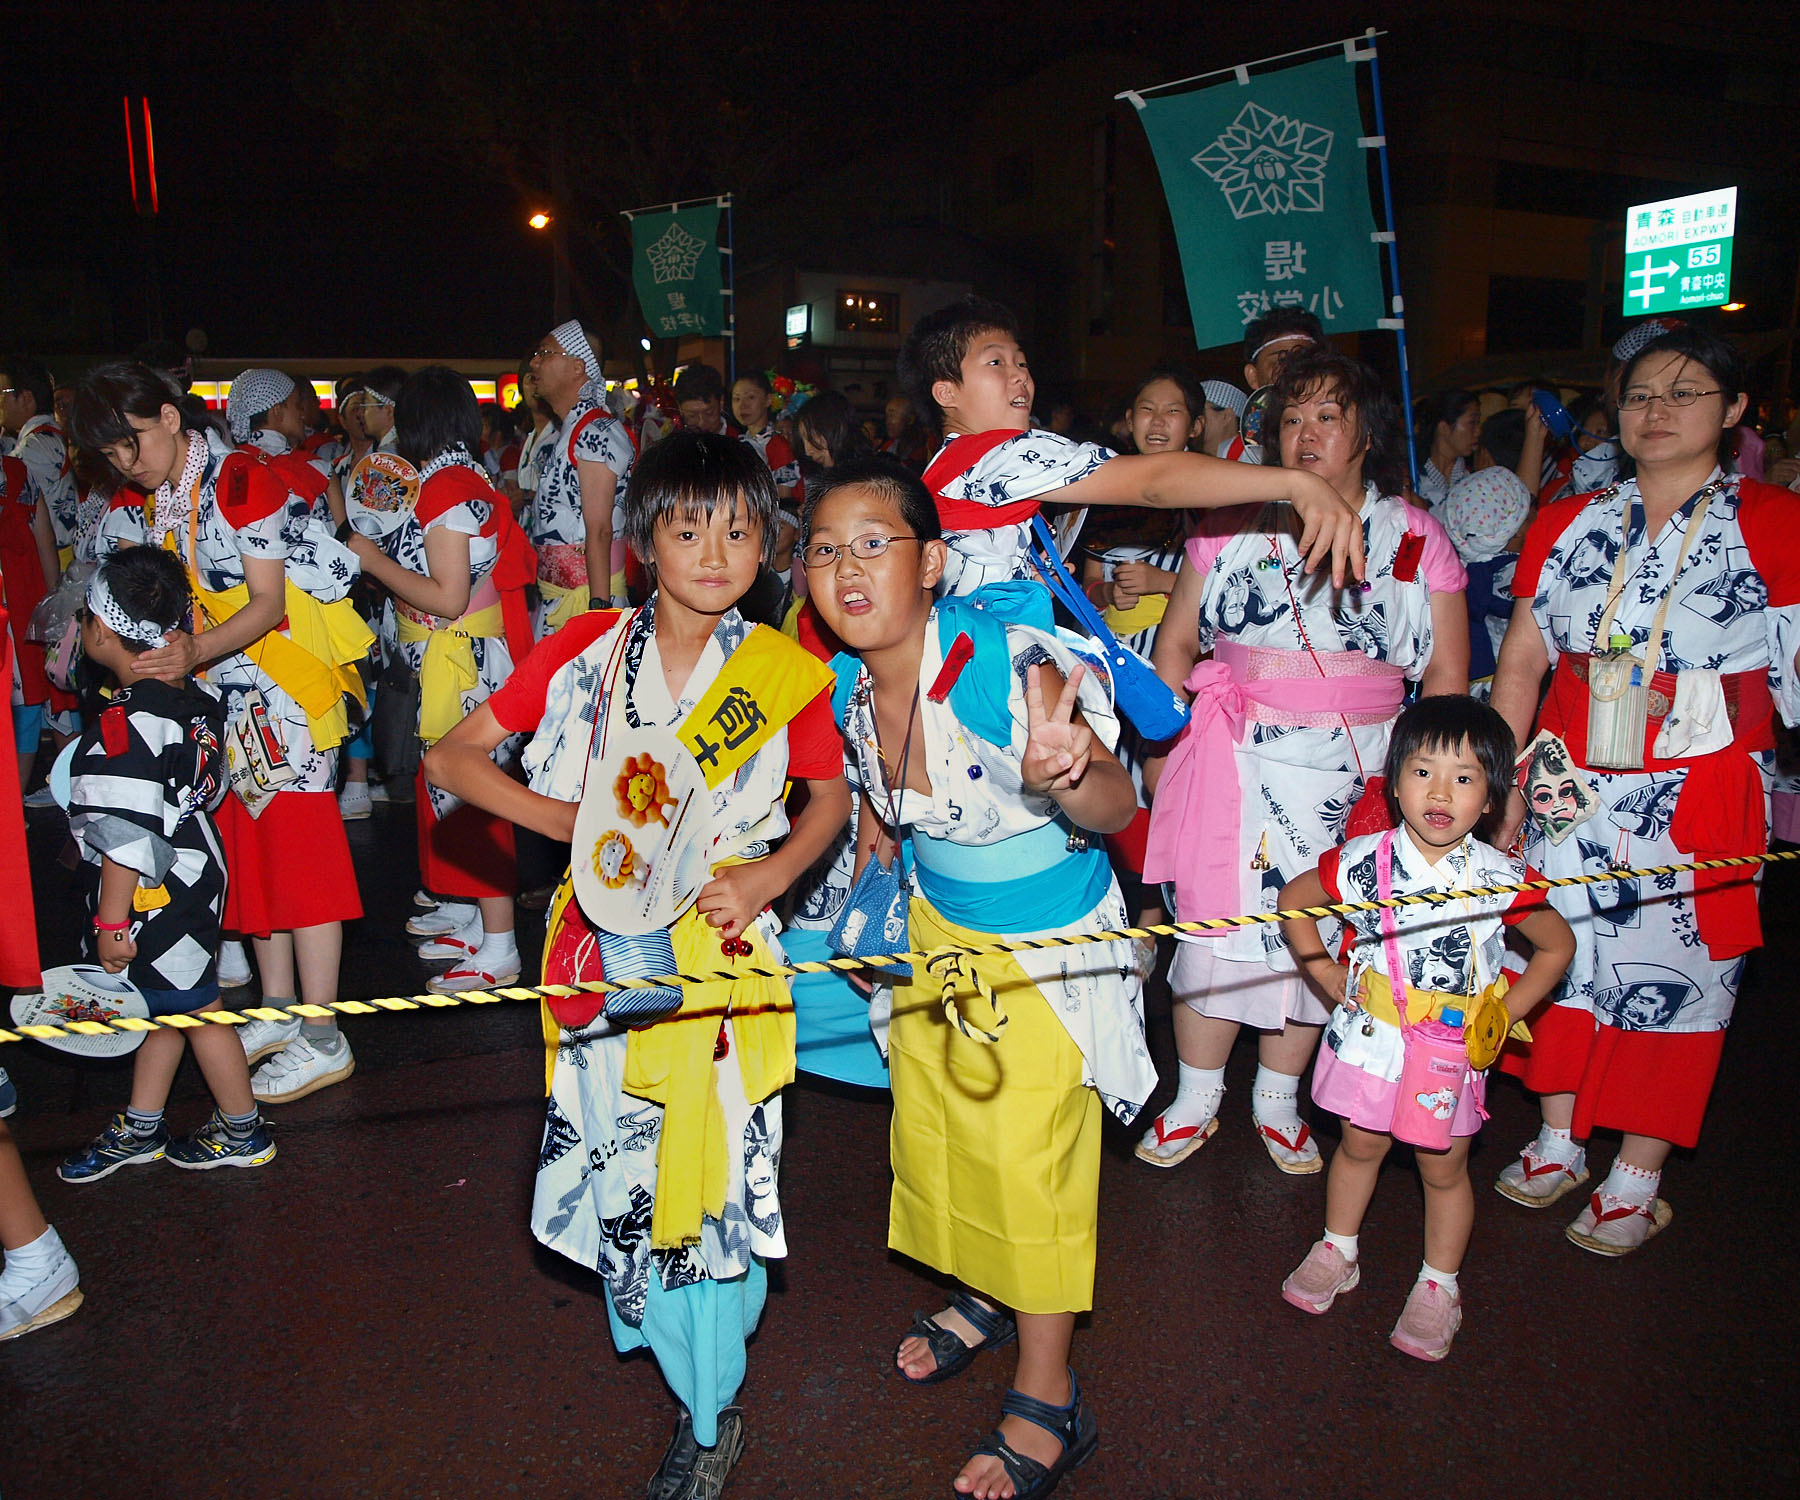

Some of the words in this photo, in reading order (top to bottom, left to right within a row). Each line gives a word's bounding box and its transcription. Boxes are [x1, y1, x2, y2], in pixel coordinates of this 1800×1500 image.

[1633, 231, 1679, 247] AOMORI
[1684, 223, 1728, 239] EXPWY
[1691, 246, 1718, 266] 55
